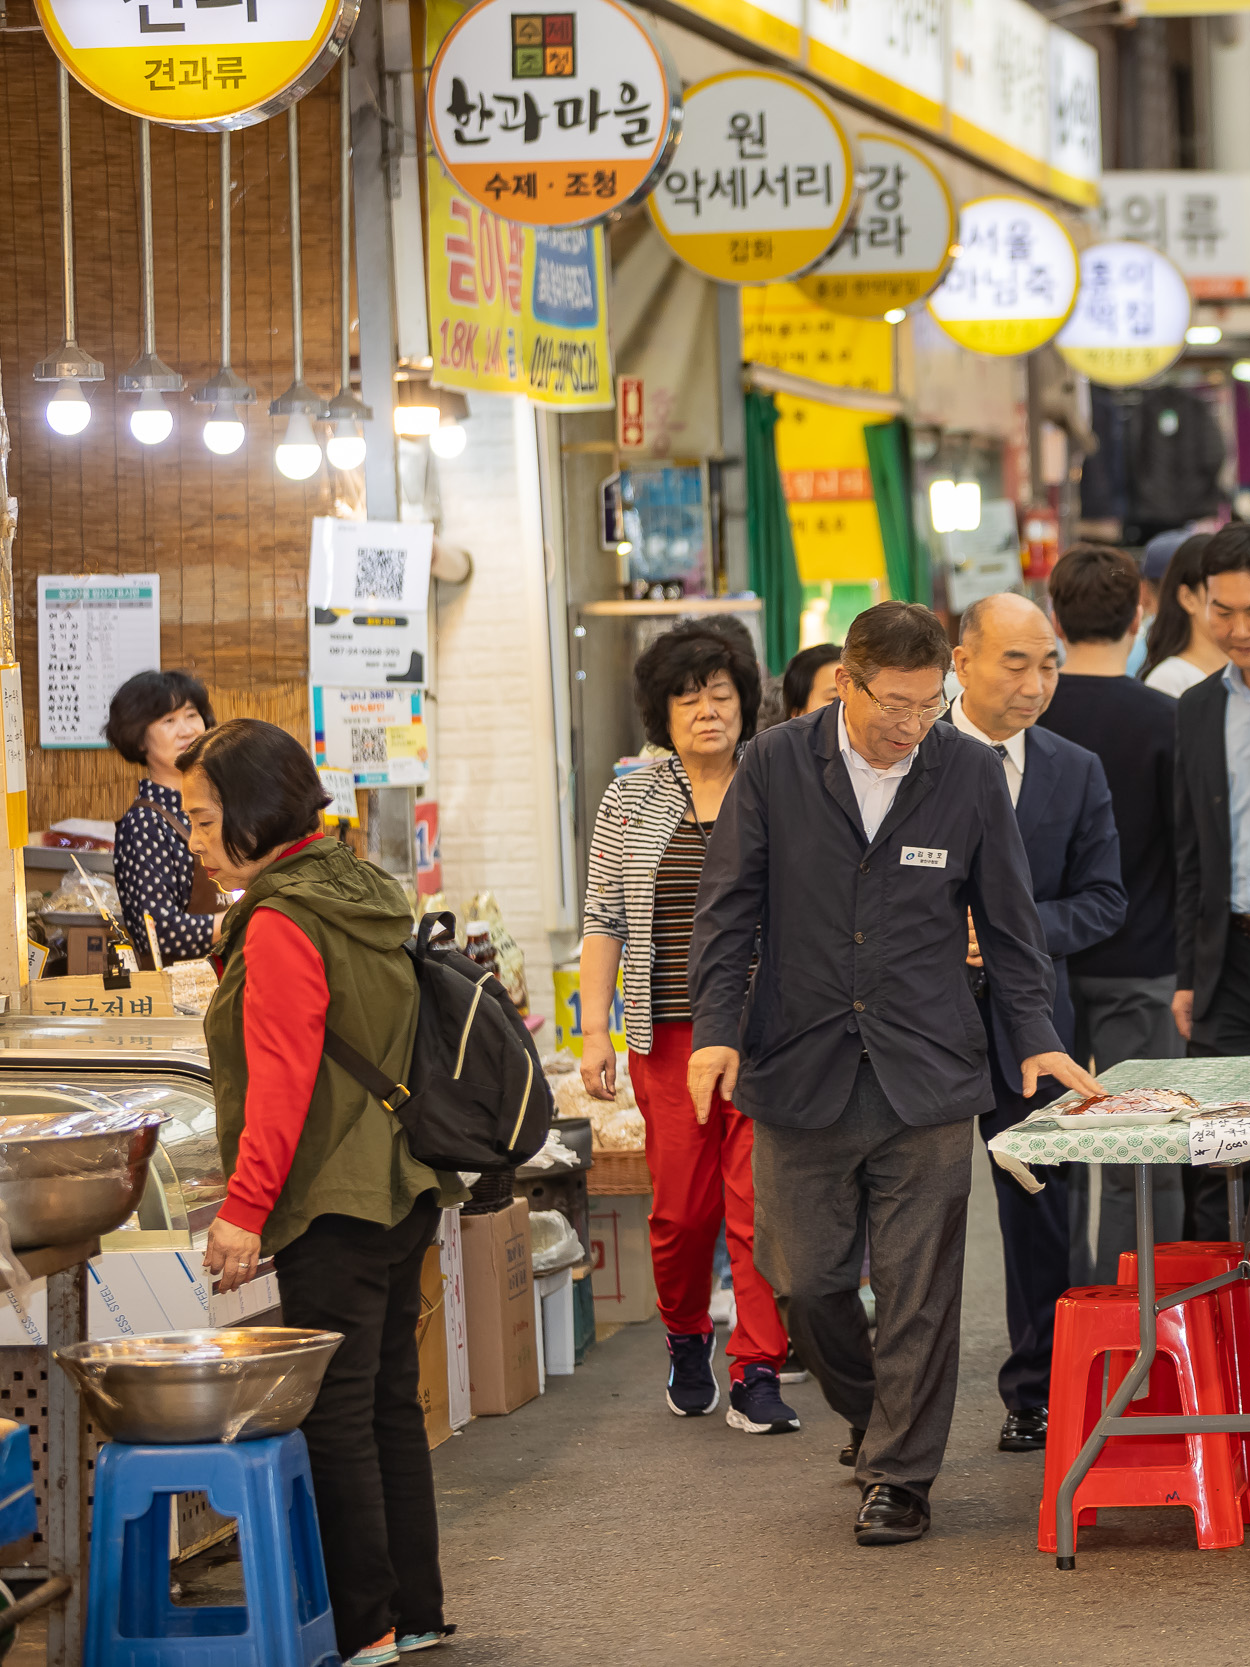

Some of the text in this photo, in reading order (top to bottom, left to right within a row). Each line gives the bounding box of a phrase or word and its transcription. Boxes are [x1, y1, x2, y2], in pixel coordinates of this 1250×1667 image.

[144, 56, 247, 91] 견과류
[726, 110, 768, 160] 원
[484, 169, 617, 200] 수제 조청
[664, 162, 833, 217] 악세서리
[865, 163, 908, 211] 강
[1099, 192, 1229, 256] 의류
[728, 236, 774, 264] 잡화
[99, 1285, 120, 1313] STEEL
